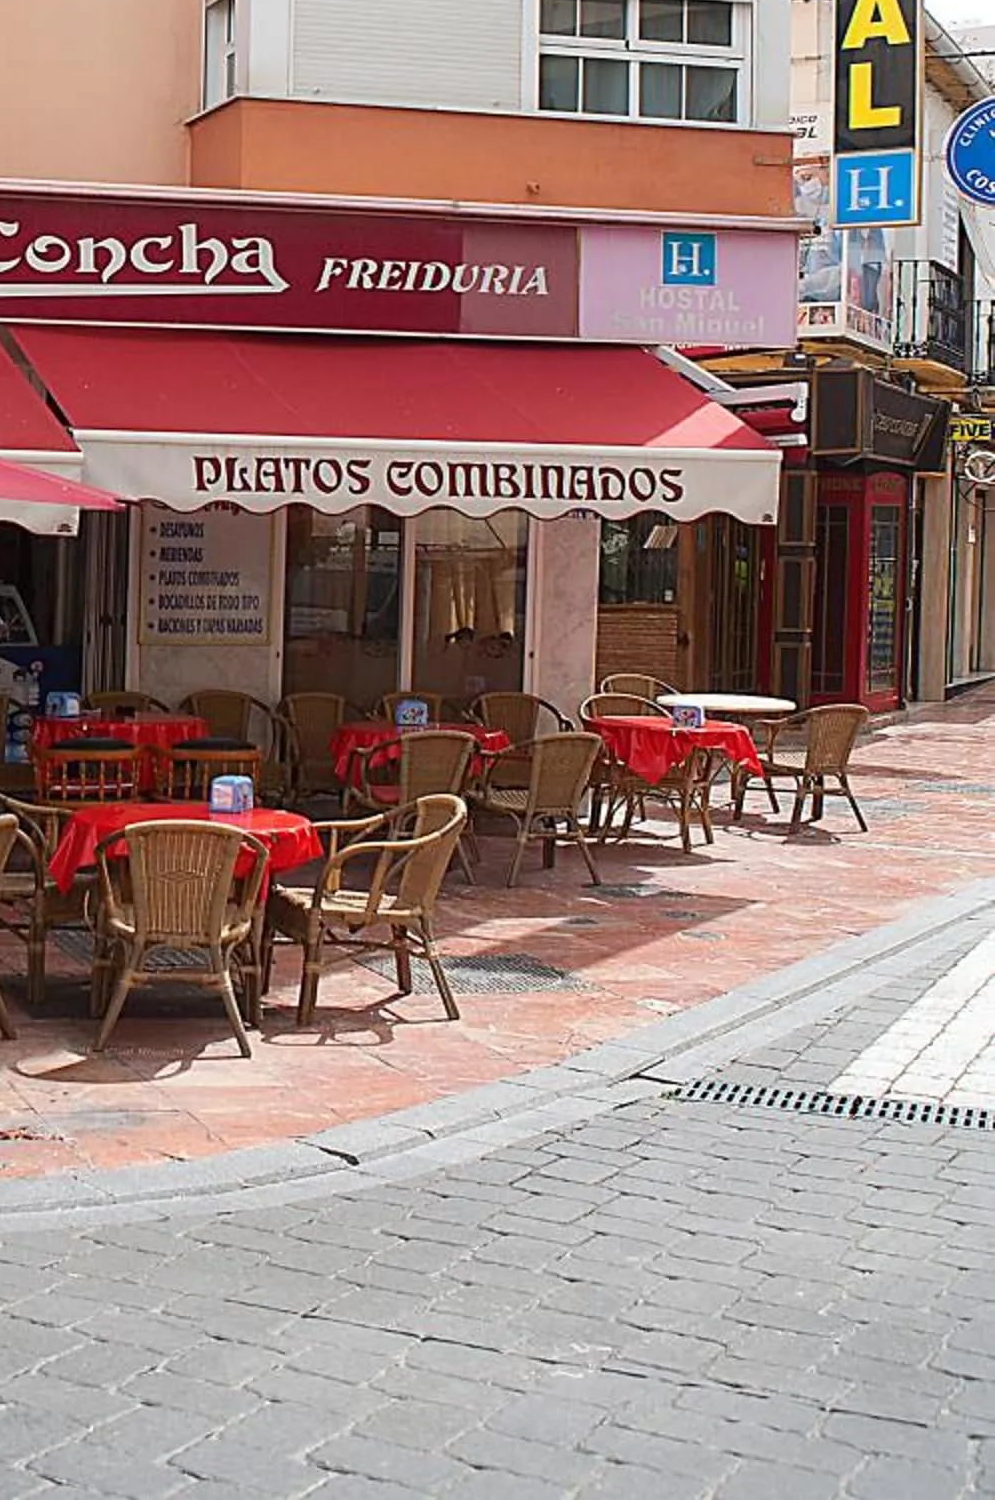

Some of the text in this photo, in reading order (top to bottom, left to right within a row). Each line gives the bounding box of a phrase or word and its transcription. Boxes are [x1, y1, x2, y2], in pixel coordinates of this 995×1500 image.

[315, 257, 550, 296] FREIDURIA
[639, 287, 741, 312] HOSTAL
[675, 312, 765, 338] Miguel
[950, 423, 990, 437] FIVE
[193, 456, 685, 502] PLATOS COMBINADOS
